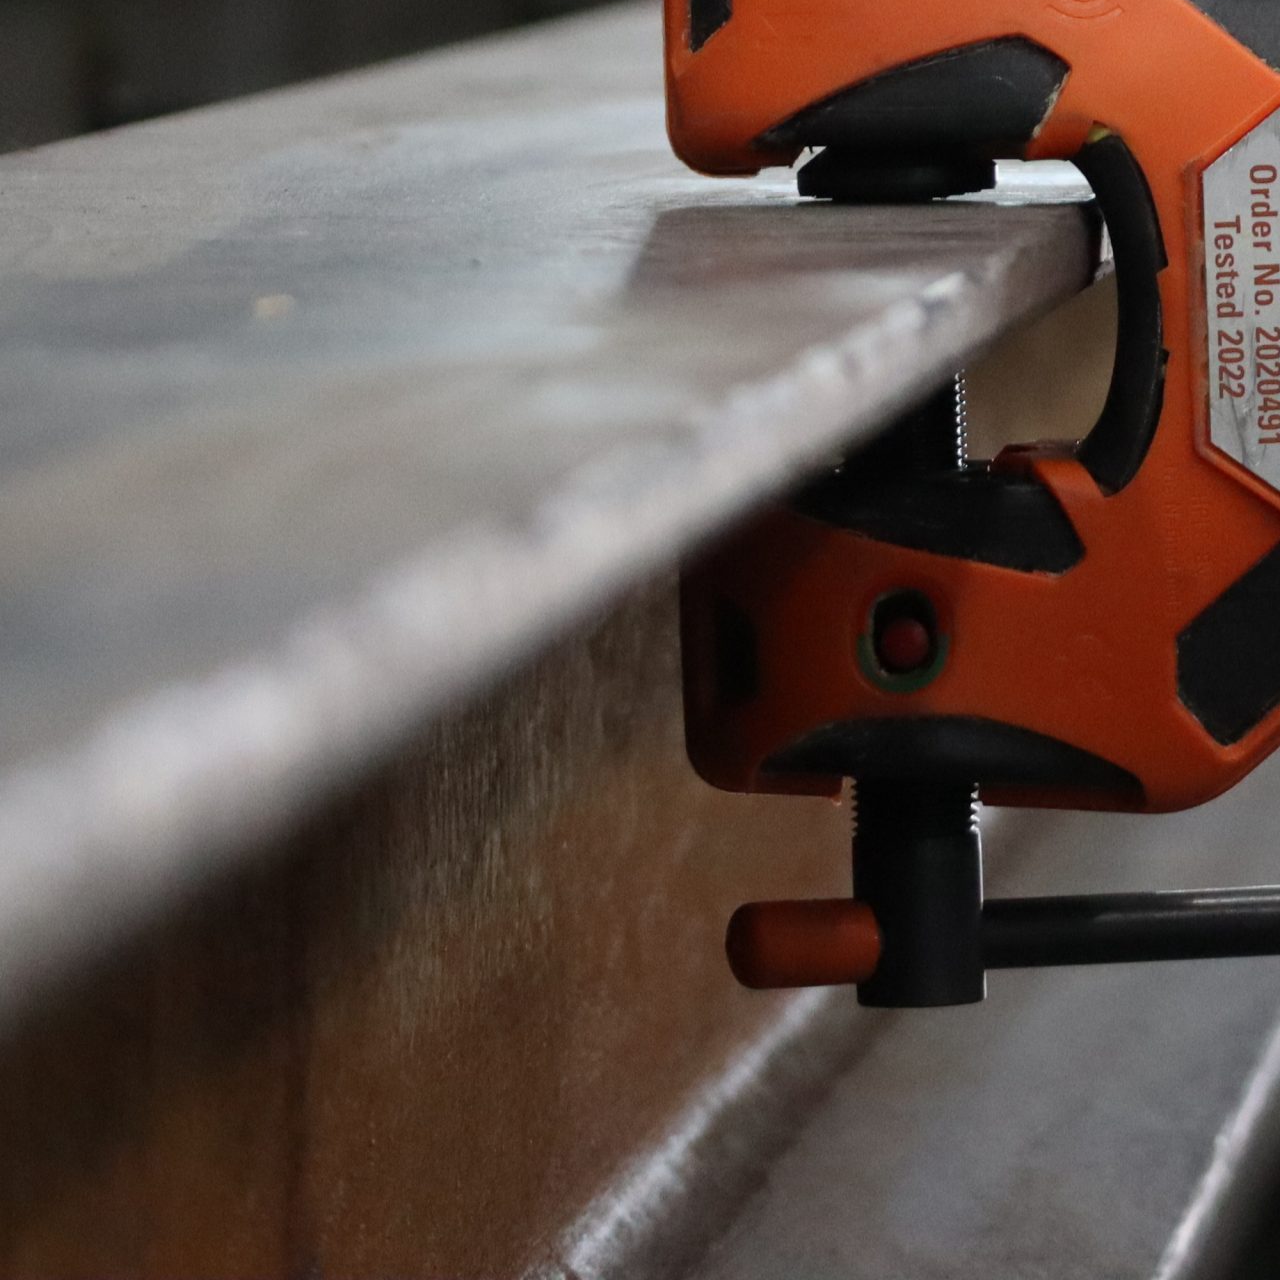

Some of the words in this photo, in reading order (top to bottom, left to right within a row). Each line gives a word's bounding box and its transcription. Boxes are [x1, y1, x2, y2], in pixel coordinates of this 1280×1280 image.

[1249, 164, 1279, 252] Order
[1213, 216, 1244, 319] Tested
[1253, 263, 1280, 316] No.
[1217, 331, 1245, 400] 2022
